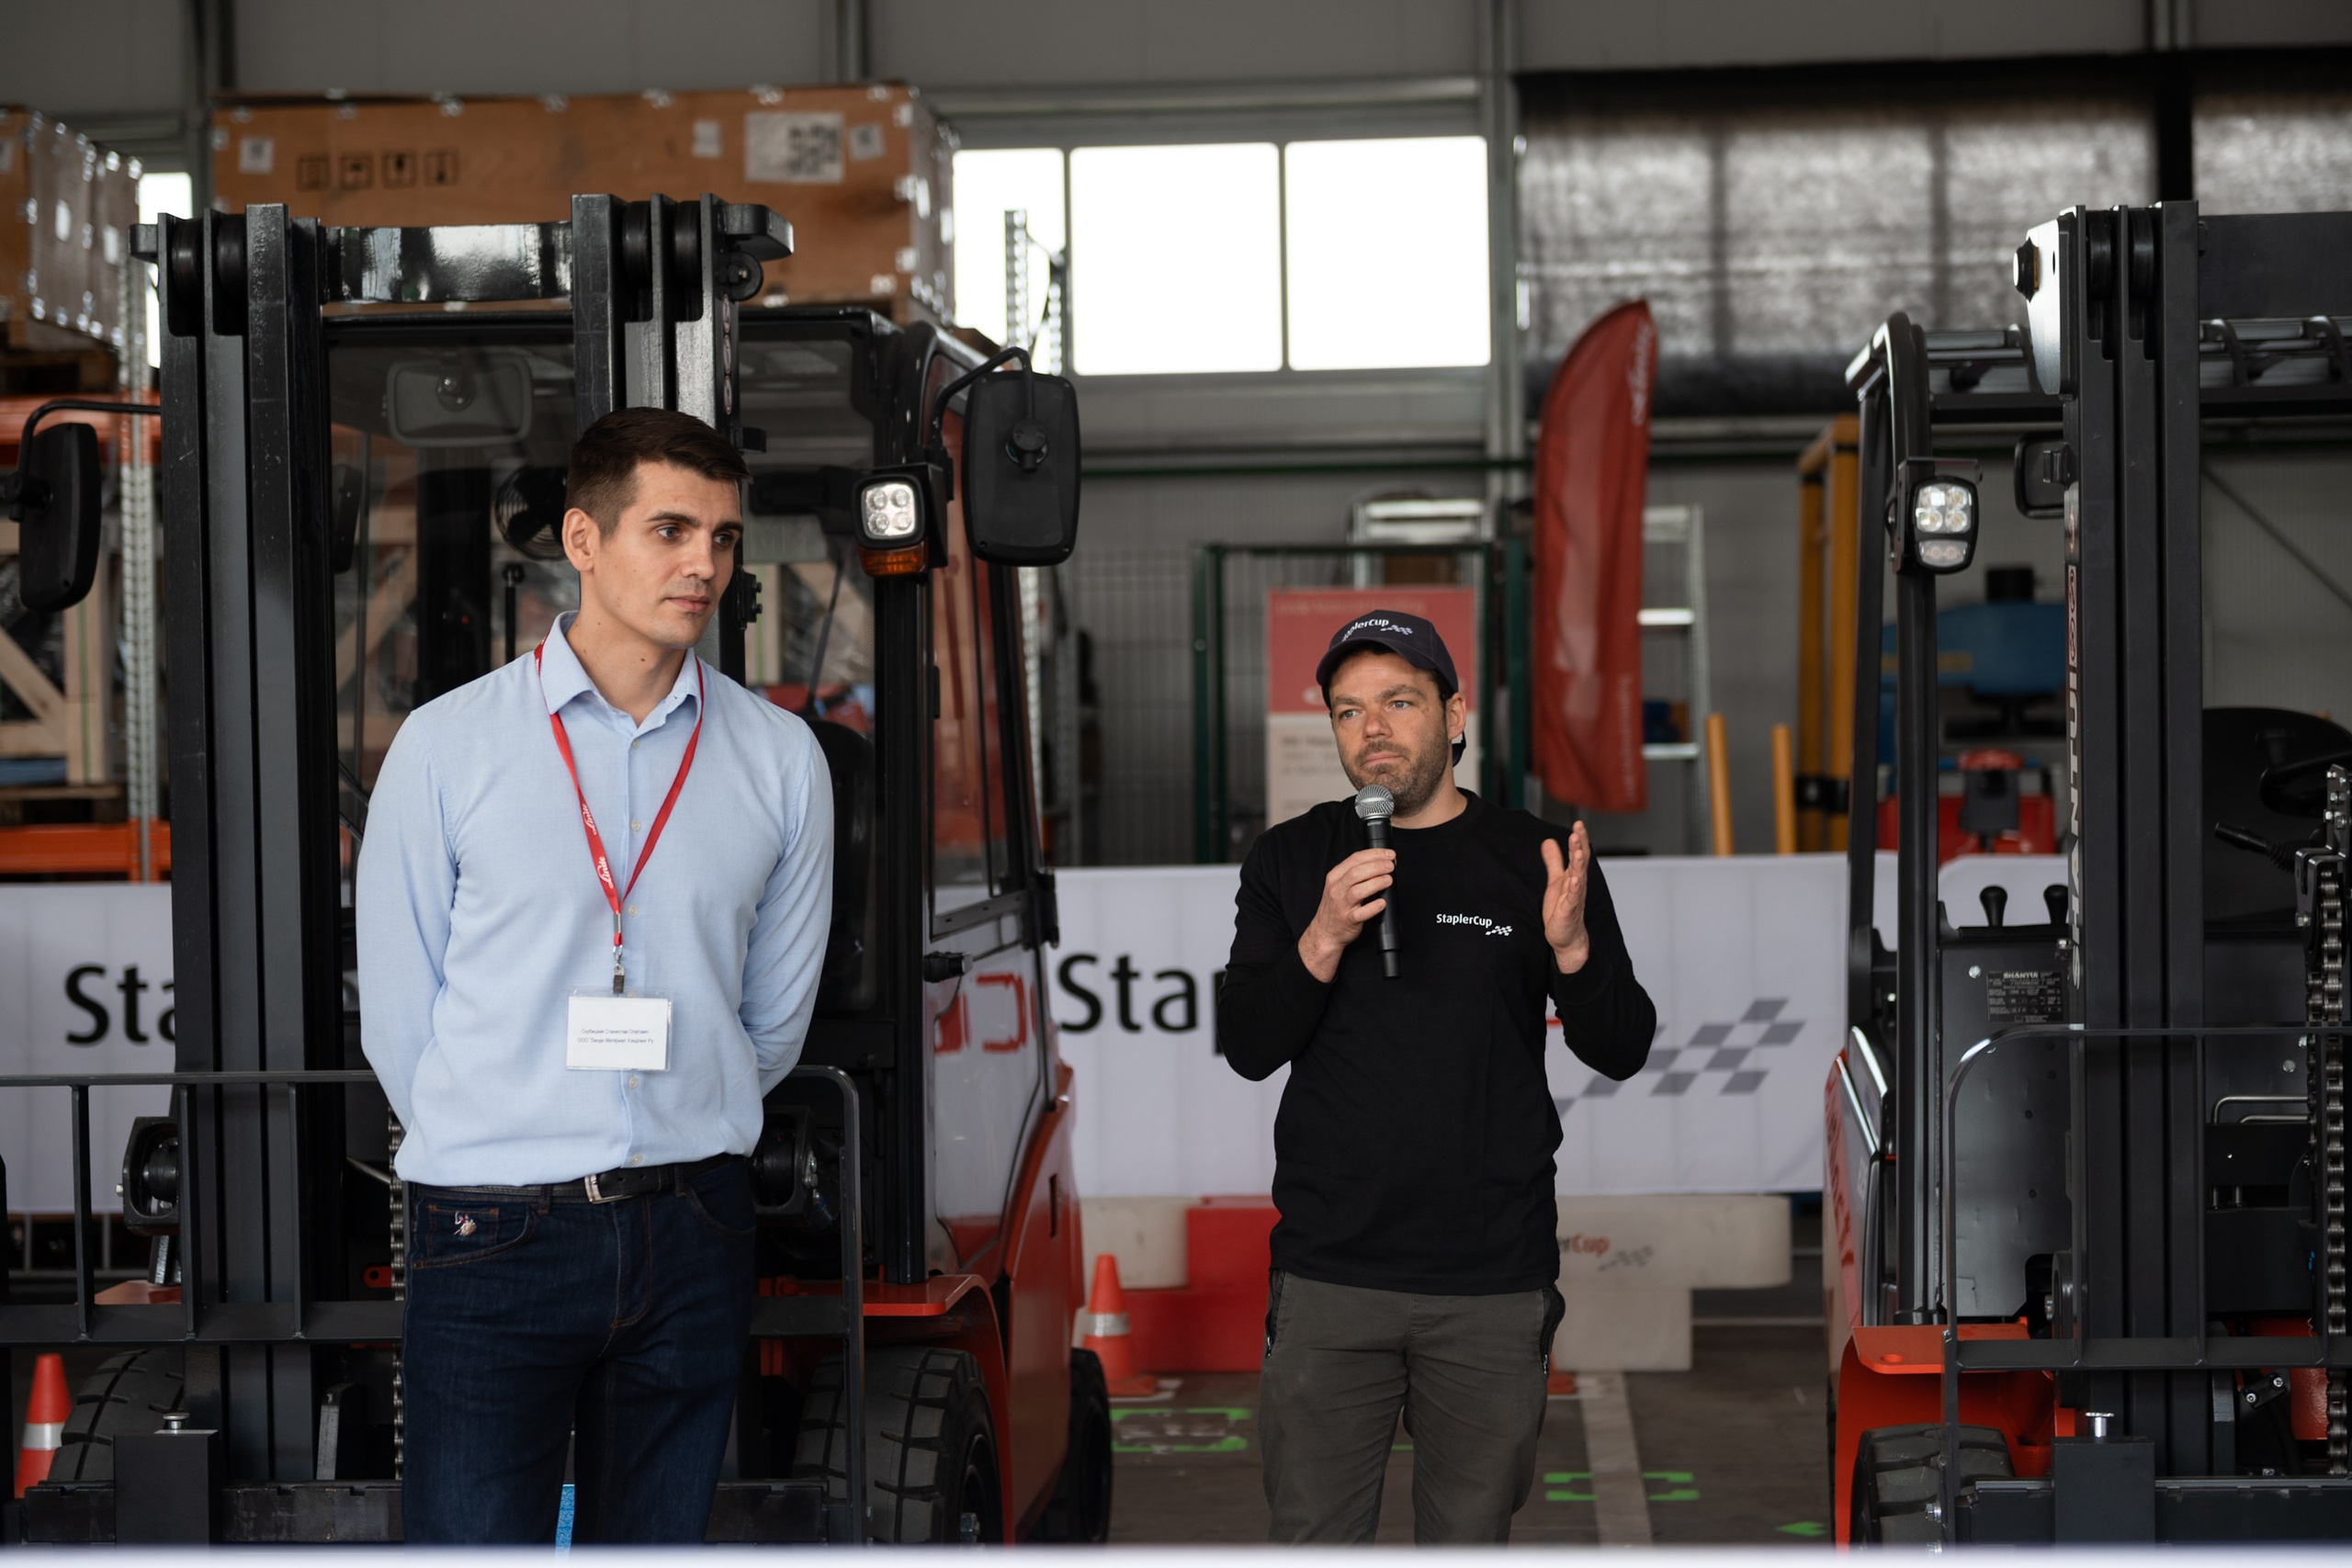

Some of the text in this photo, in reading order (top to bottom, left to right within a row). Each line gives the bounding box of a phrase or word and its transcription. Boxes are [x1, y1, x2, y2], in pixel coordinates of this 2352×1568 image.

[582, 804, 598, 835] Linde
[2068, 671, 2080, 990] SHANTUI
[596, 855, 615, 889] Linde
[1436, 913, 1493, 929] StaplerCup
[1057, 953, 1226, 1055] Sta
